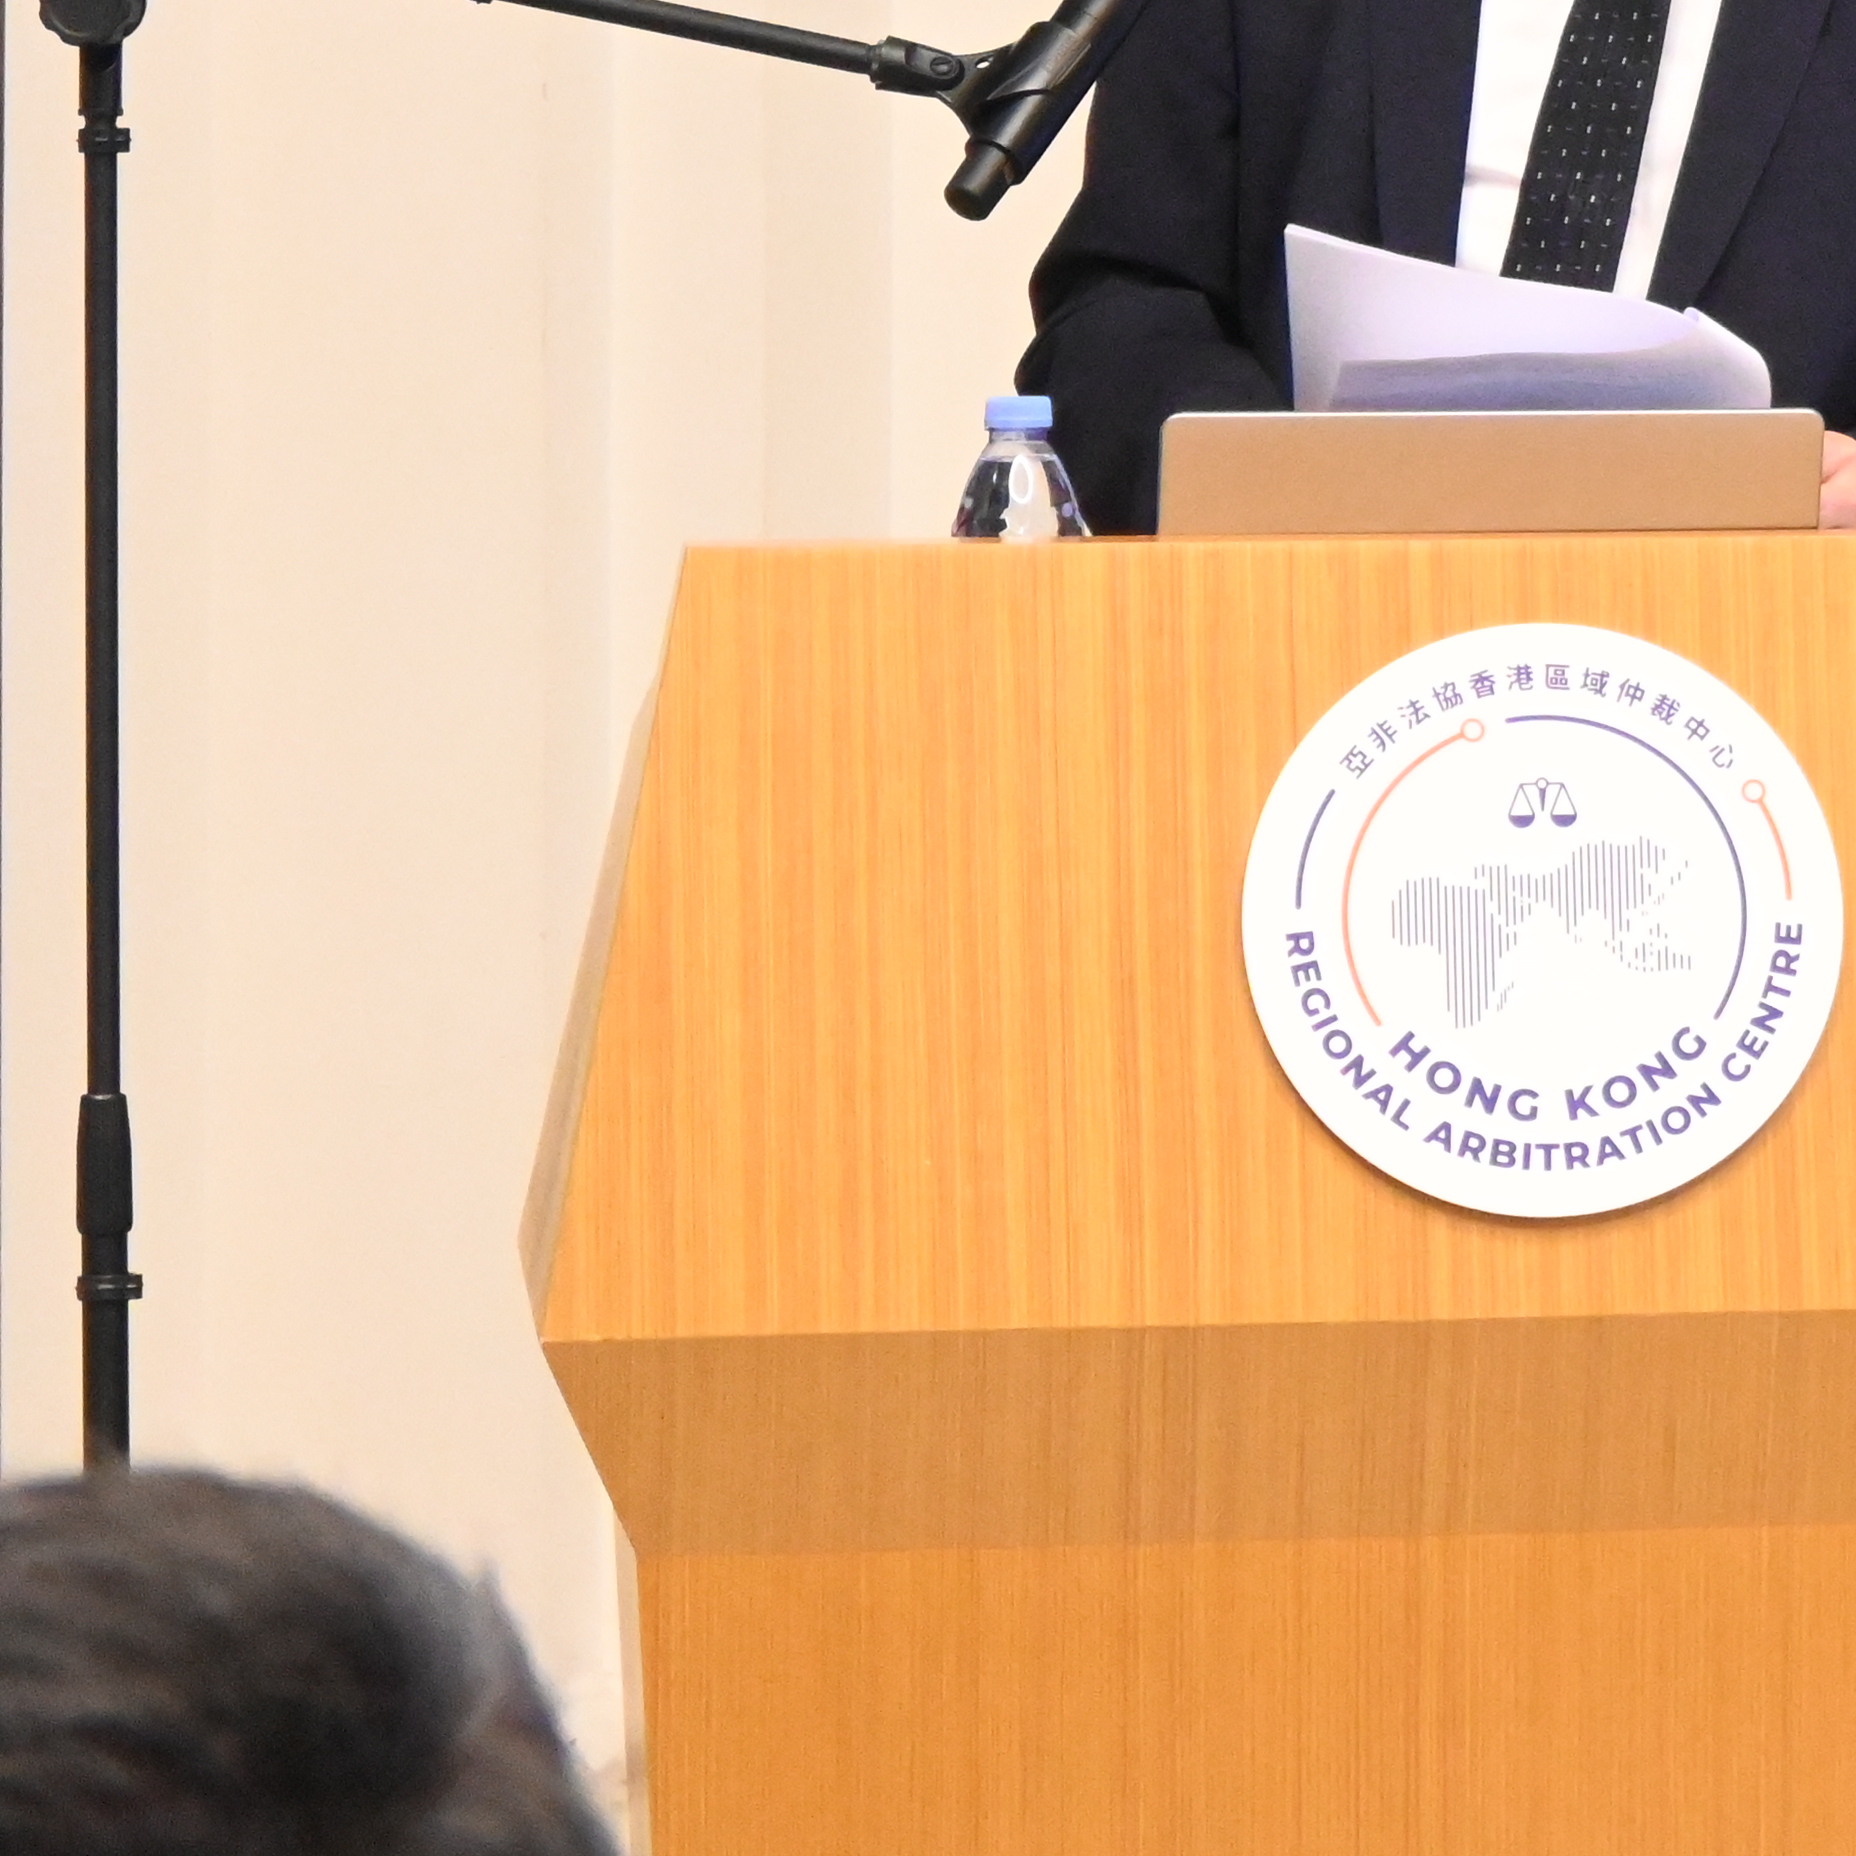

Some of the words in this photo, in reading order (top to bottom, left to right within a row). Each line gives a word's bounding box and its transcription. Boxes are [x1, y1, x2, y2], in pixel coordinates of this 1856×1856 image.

[1339, 664, 1734, 778] 亞非法協香港區域仲裁中心
[1285, 930, 1414, 1130] REGIONAL
[1423, 1082, 1722, 1171] ARBITRATION
[1721, 920, 1804, 1081] CENTRE
[1389, 1030, 1540, 1122] HONG
[1565, 1025, 1709, 1121] KONG
